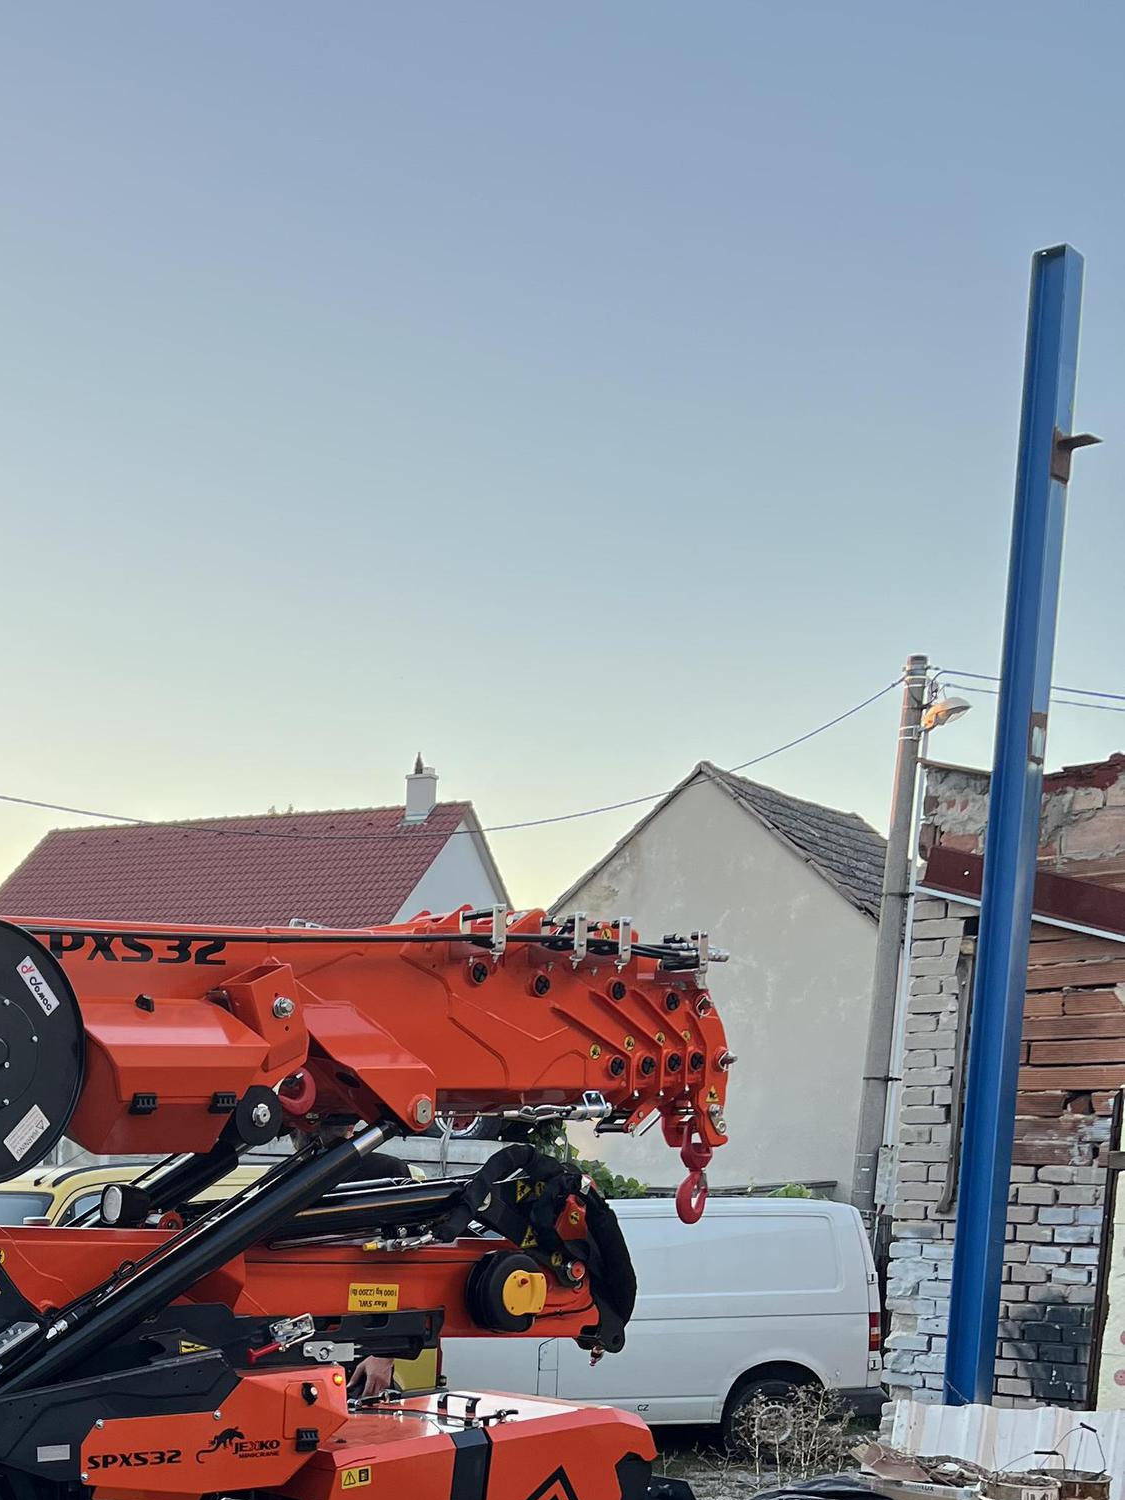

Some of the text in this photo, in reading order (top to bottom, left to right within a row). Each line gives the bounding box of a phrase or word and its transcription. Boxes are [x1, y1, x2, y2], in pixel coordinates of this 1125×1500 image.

[49, 932, 226, 965] PXS32
[376, 1287, 383, 1296] kg
[87, 1450, 182, 1470] SPXS32
